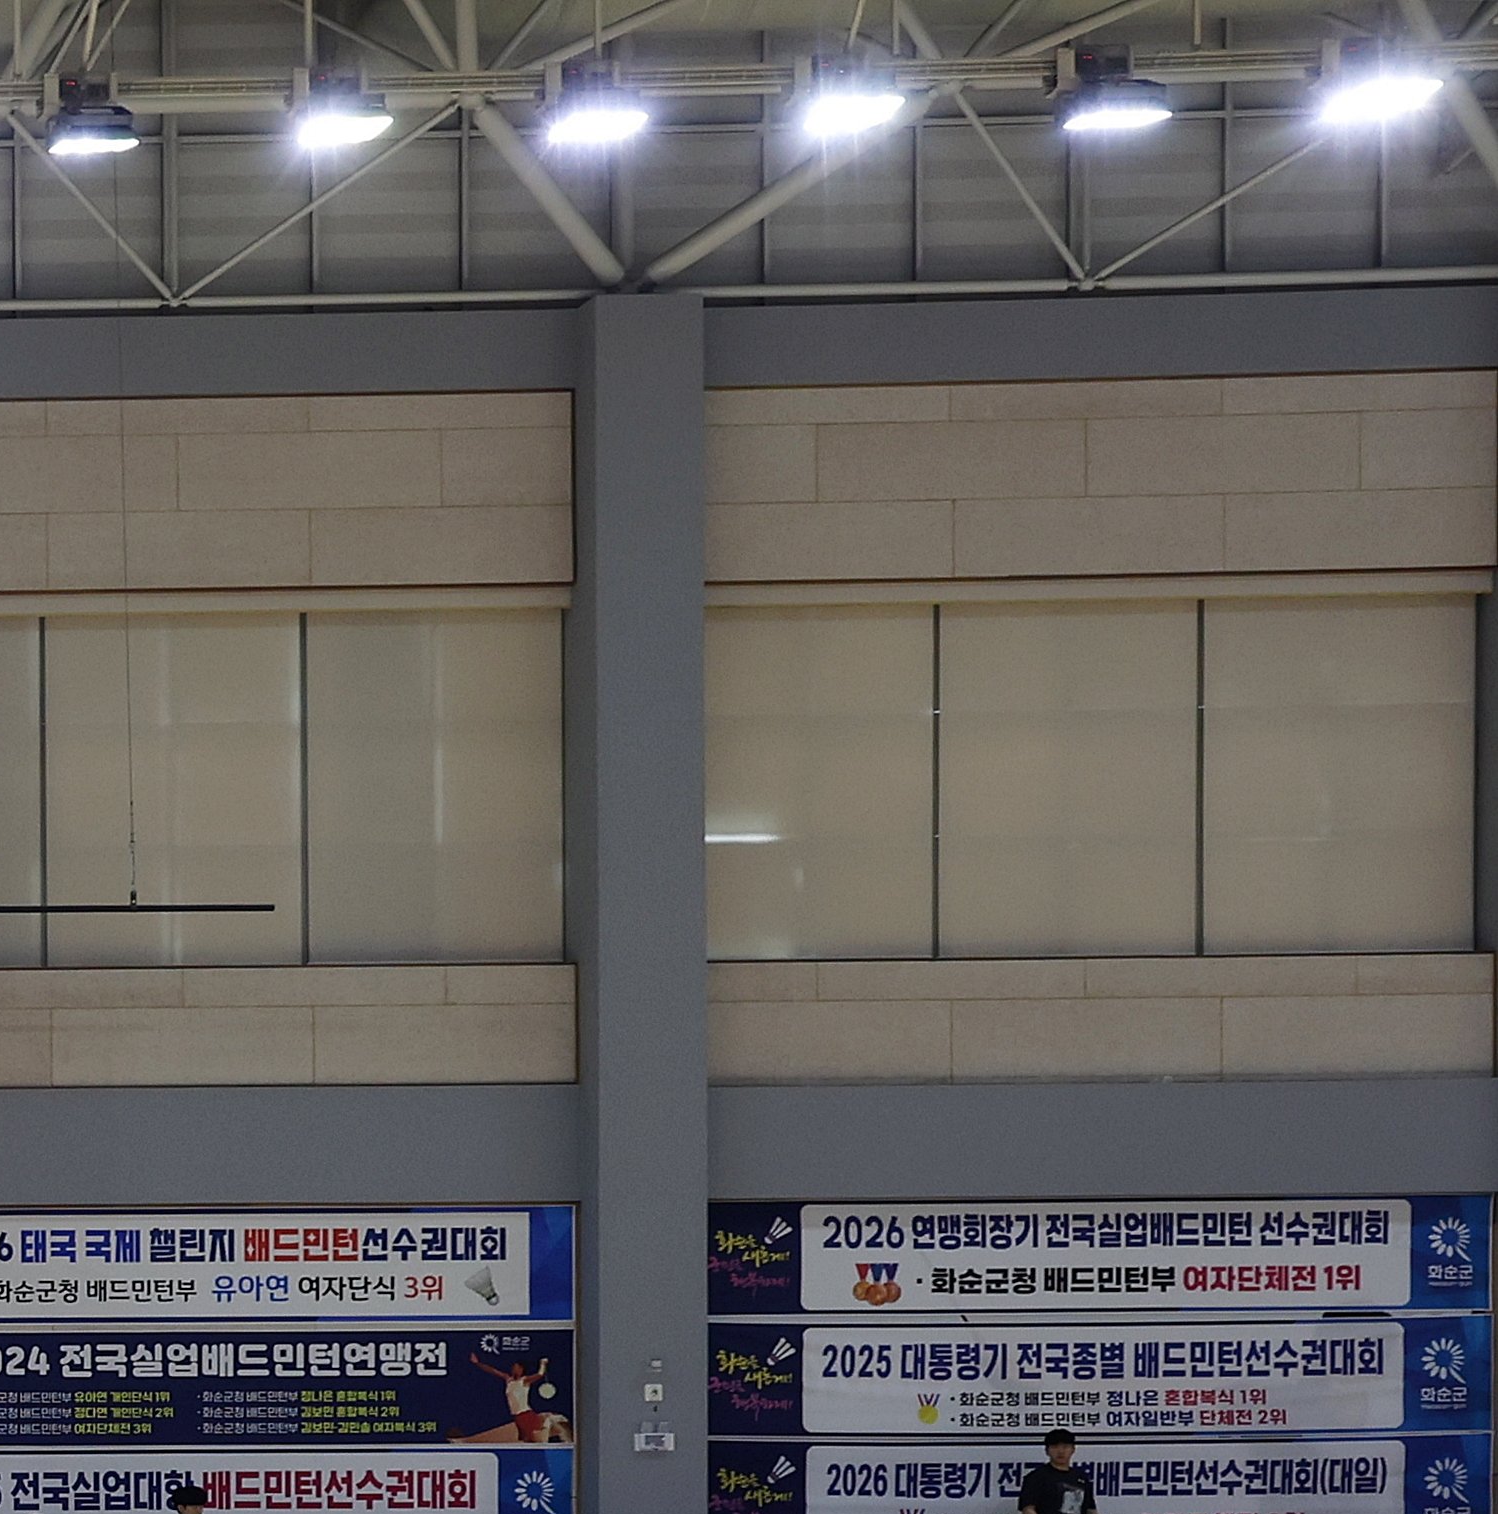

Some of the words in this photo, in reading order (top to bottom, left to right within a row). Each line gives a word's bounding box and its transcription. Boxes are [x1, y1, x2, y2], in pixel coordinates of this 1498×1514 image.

[20, 1229, 77, 1264] 태국
[85, 1228, 141, 1264] 국제
[150, 1227, 235, 1263] 챌린지
[244, 1226, 506, 1263] 배드민턴선수권대회
[822, 1215, 905, 1250] 2026
[911, 1214, 1038, 1250] 연맹회장기
[1045, 1210, 1252, 1249] 전국실업배드민턴
[1259, 1209, 1389, 1246] 선수권대회
[86, 1278, 197, 1303] 배드민턴부
[212, 1275, 289, 1302] 유아연
[298, 1275, 396, 1301] 여자단식
[404, 1275, 443, 1300] 3위
[930, 1267, 1036, 1295] 화순군청
[1044, 1266, 1176, 1294] 배드민턴부
[1183, 1265, 1317, 1292] 여자단체전
[1324, 1265, 1361, 1291] 1위
[59, 1341, 448, 1377] 전국실업배드민턴연맹전
[822, 1344, 892, 1379] 2025
[901, 1343, 1007, 1380] 대통령기
[1016, 1342, 1124, 1380] 전국종별
[1133, 1338, 1384, 1379] 배드민턴선수권대회
[959, 1392, 1020, 1408] 화순군청
[1025, 1391, 1100, 1407] 배드민턴부
[1107, 1390, 1159, 1407] 정나은
[1165, 1389, 1234, 1406] 혼합복식
[1239, 1388, 1267, 1405] 1위
[1420, 1386, 1467, 1403] 화순군
[959, 1412, 1020, 1428] 화순군청
[1025, 1411, 1100, 1427] 배드민턴부
[1107, 1410, 1194, 1426] 여자일반부
[1200, 1409, 1252, 1426] 단체전
[1258, 1408, 1287, 1425] 2위
[202, 1469, 476, 1511] 배드민턴선수권대회
[827, 1463, 888, 1497] 2026
[894, 1462, 991, 1499] 대통령기
